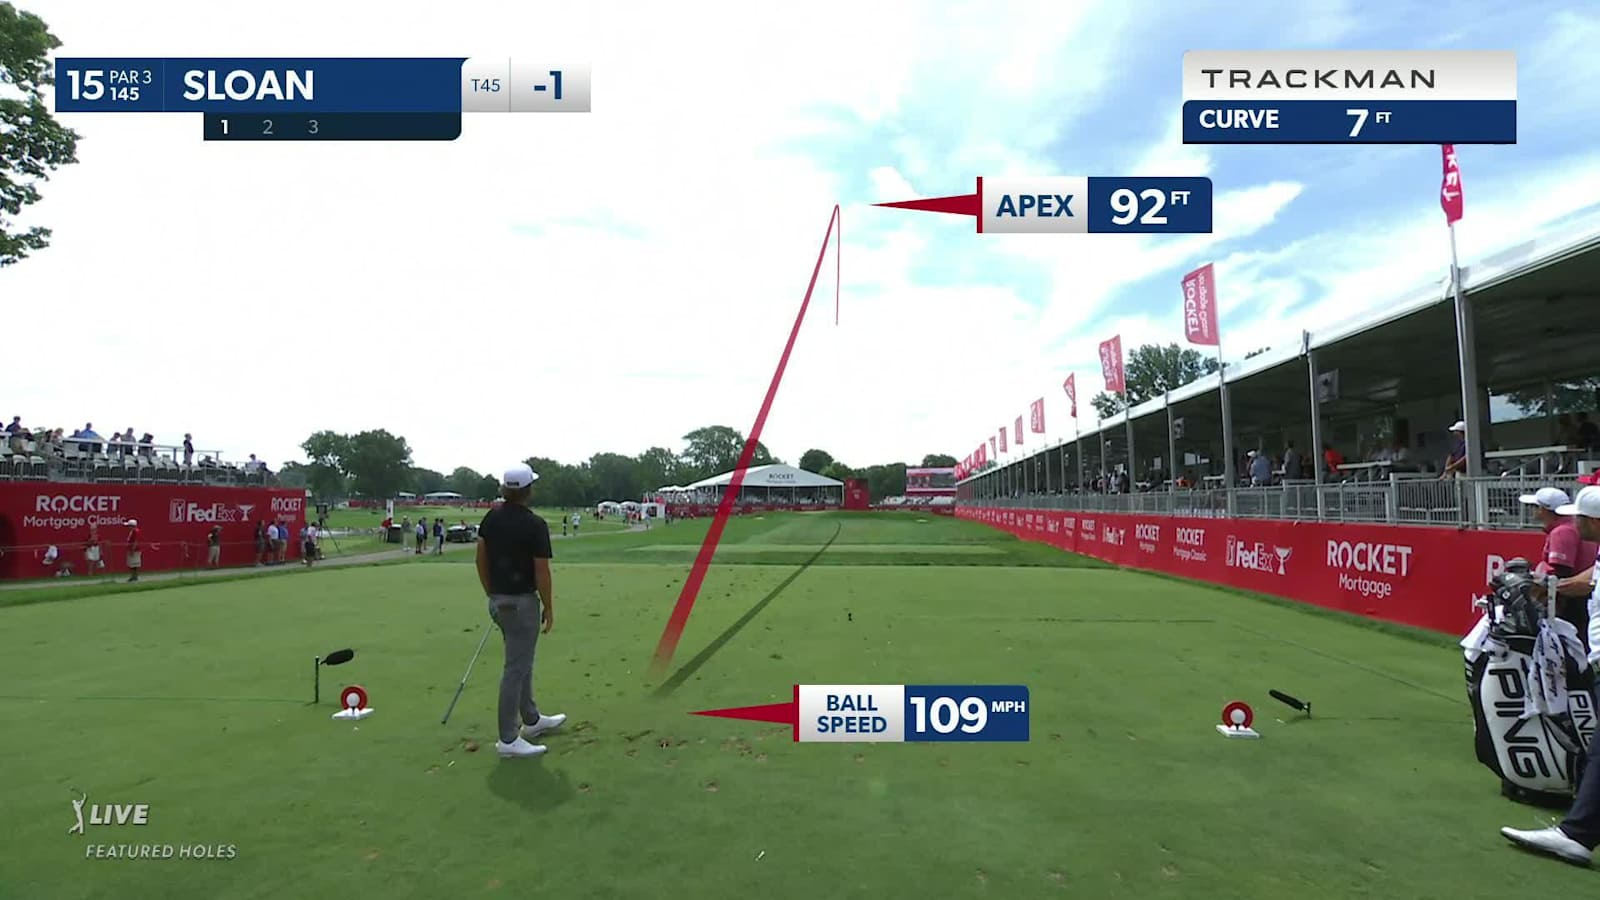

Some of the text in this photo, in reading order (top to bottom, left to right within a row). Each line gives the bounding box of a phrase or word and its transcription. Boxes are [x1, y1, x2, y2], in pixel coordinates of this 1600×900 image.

[36, 495, 120, 513] ROCKET
[187, 502, 236, 522] FedEx
[271, 497, 302, 512] ROCKET
[23, 515, 127, 529] Mortgage Classic
[1176, 527, 1205, 546] ROCKET
[1236, 540, 1274, 573] FedEx
[1327, 539, 1412, 577] ROCKET
[1339, 572, 1392, 599] Mortgage
[1488, 668, 1551, 778] PING
